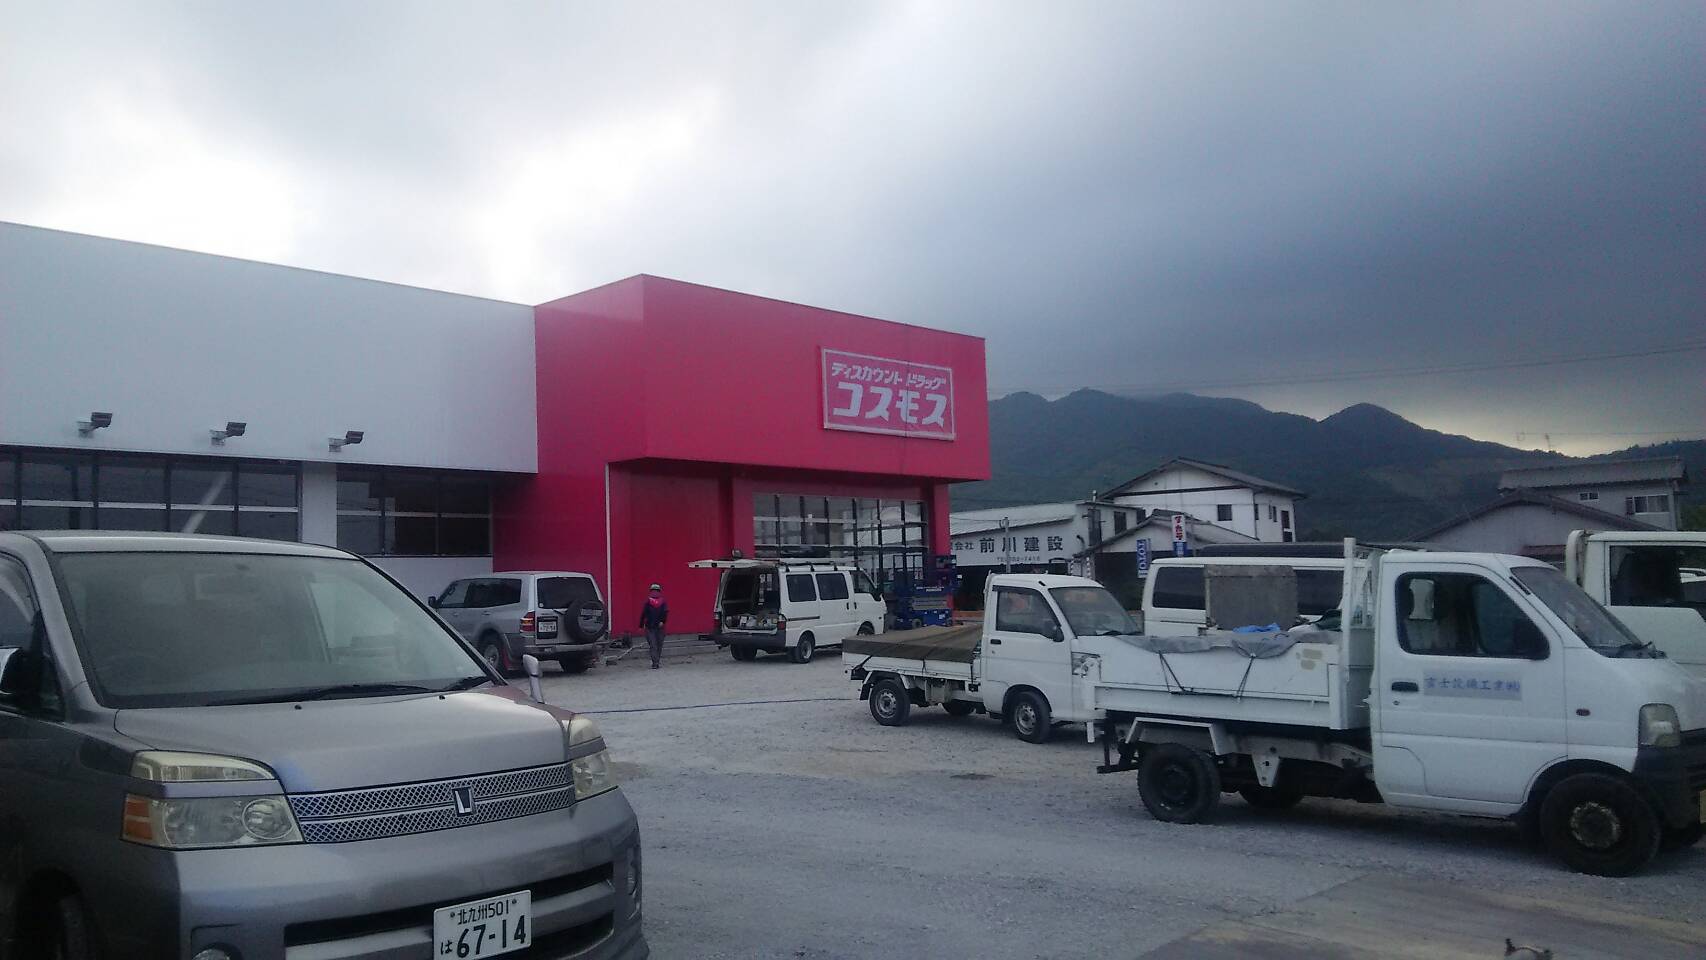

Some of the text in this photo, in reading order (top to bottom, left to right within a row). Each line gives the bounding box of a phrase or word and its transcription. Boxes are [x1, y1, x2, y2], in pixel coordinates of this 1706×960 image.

[832, 362, 947, 390] ディスカウント ドラッグ
[833, 381, 947, 428] コスモス
[980, 535, 1063, 553] 前川建設
[440, 915, 526, 958] は 67-14
